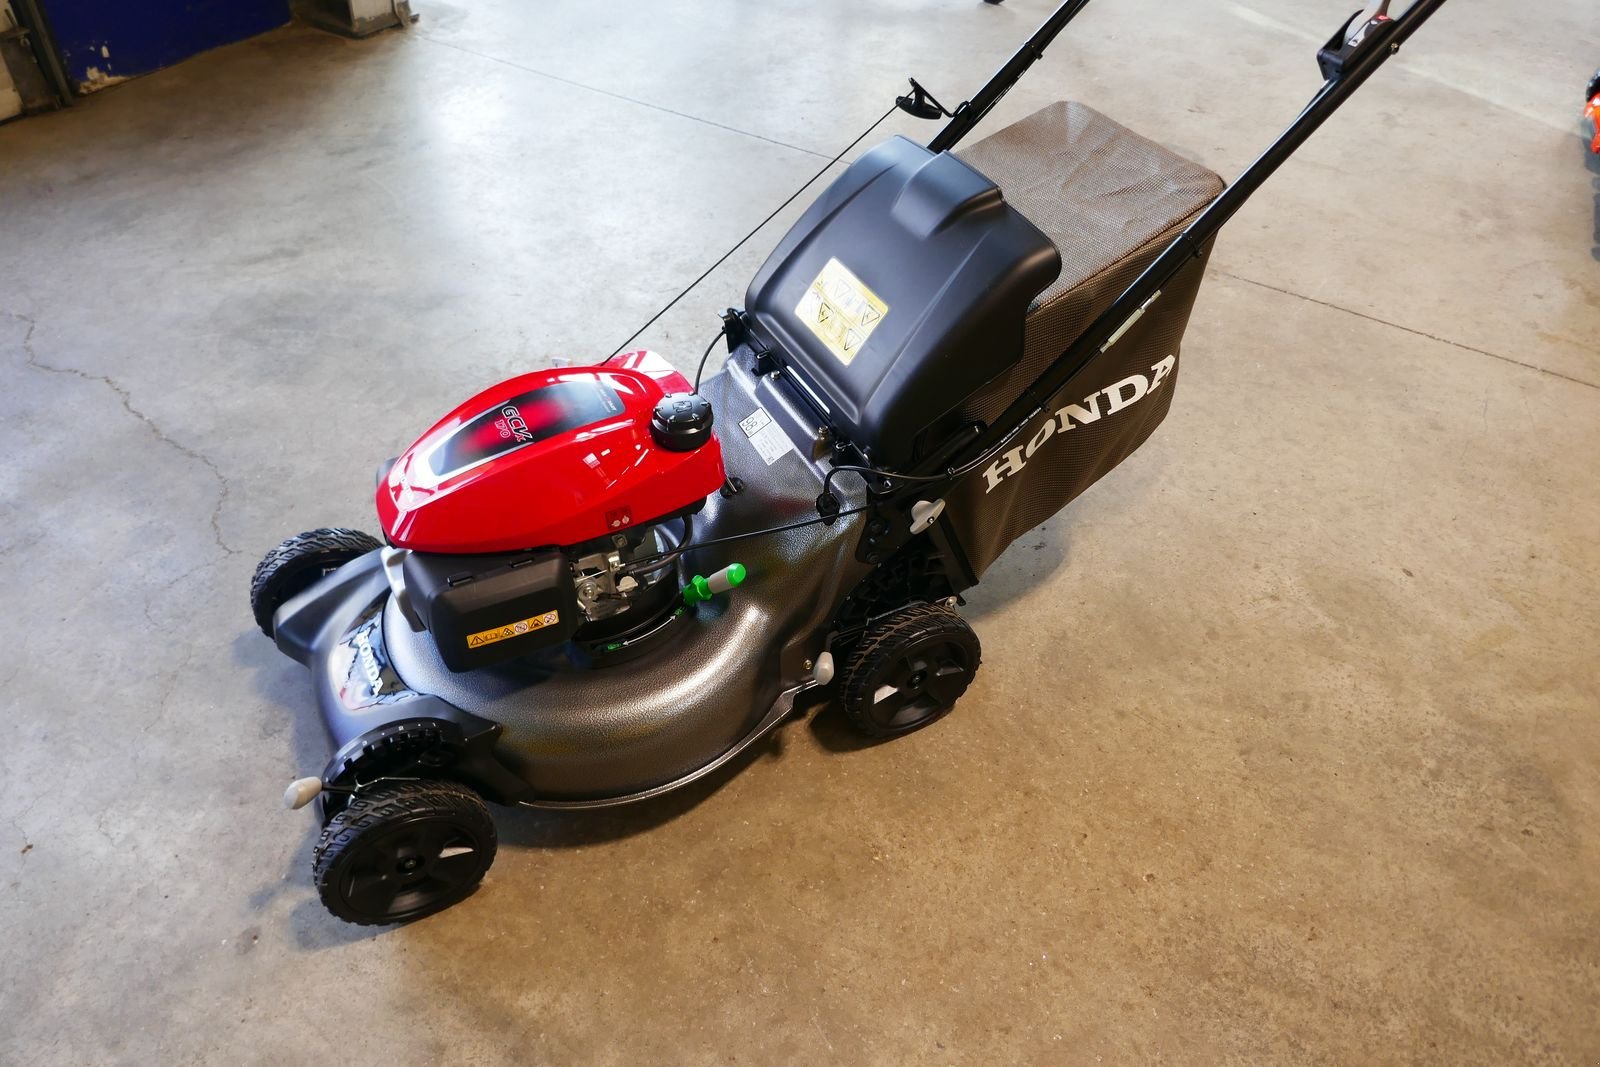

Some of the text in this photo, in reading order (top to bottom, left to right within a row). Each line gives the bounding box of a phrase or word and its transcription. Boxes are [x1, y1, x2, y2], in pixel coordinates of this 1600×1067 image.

[494, 418, 511, 439] 170
[742, 416, 758, 431] 98
[982, 354, 1176, 494] HONDA
[352, 627, 384, 696] HONDA
